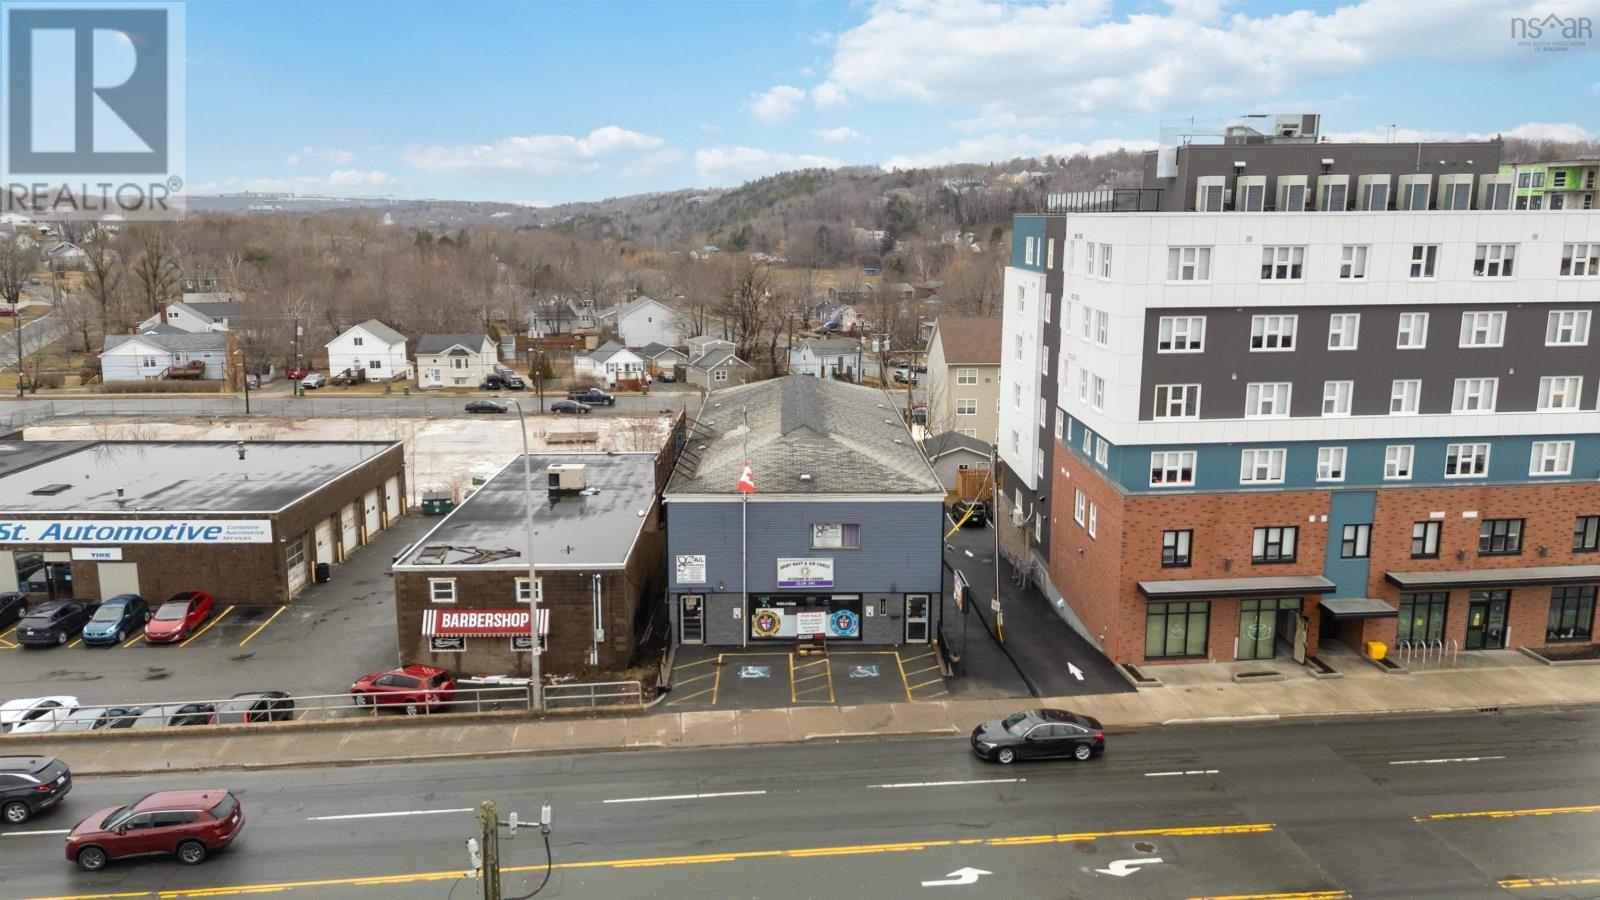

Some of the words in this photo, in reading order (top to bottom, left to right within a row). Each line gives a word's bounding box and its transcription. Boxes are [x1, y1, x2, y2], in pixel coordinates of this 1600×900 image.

[0, 523, 29, 541] St.
[38, 523, 222, 541] Automotive
[441, 612, 530, 628] BARBERSHOP
